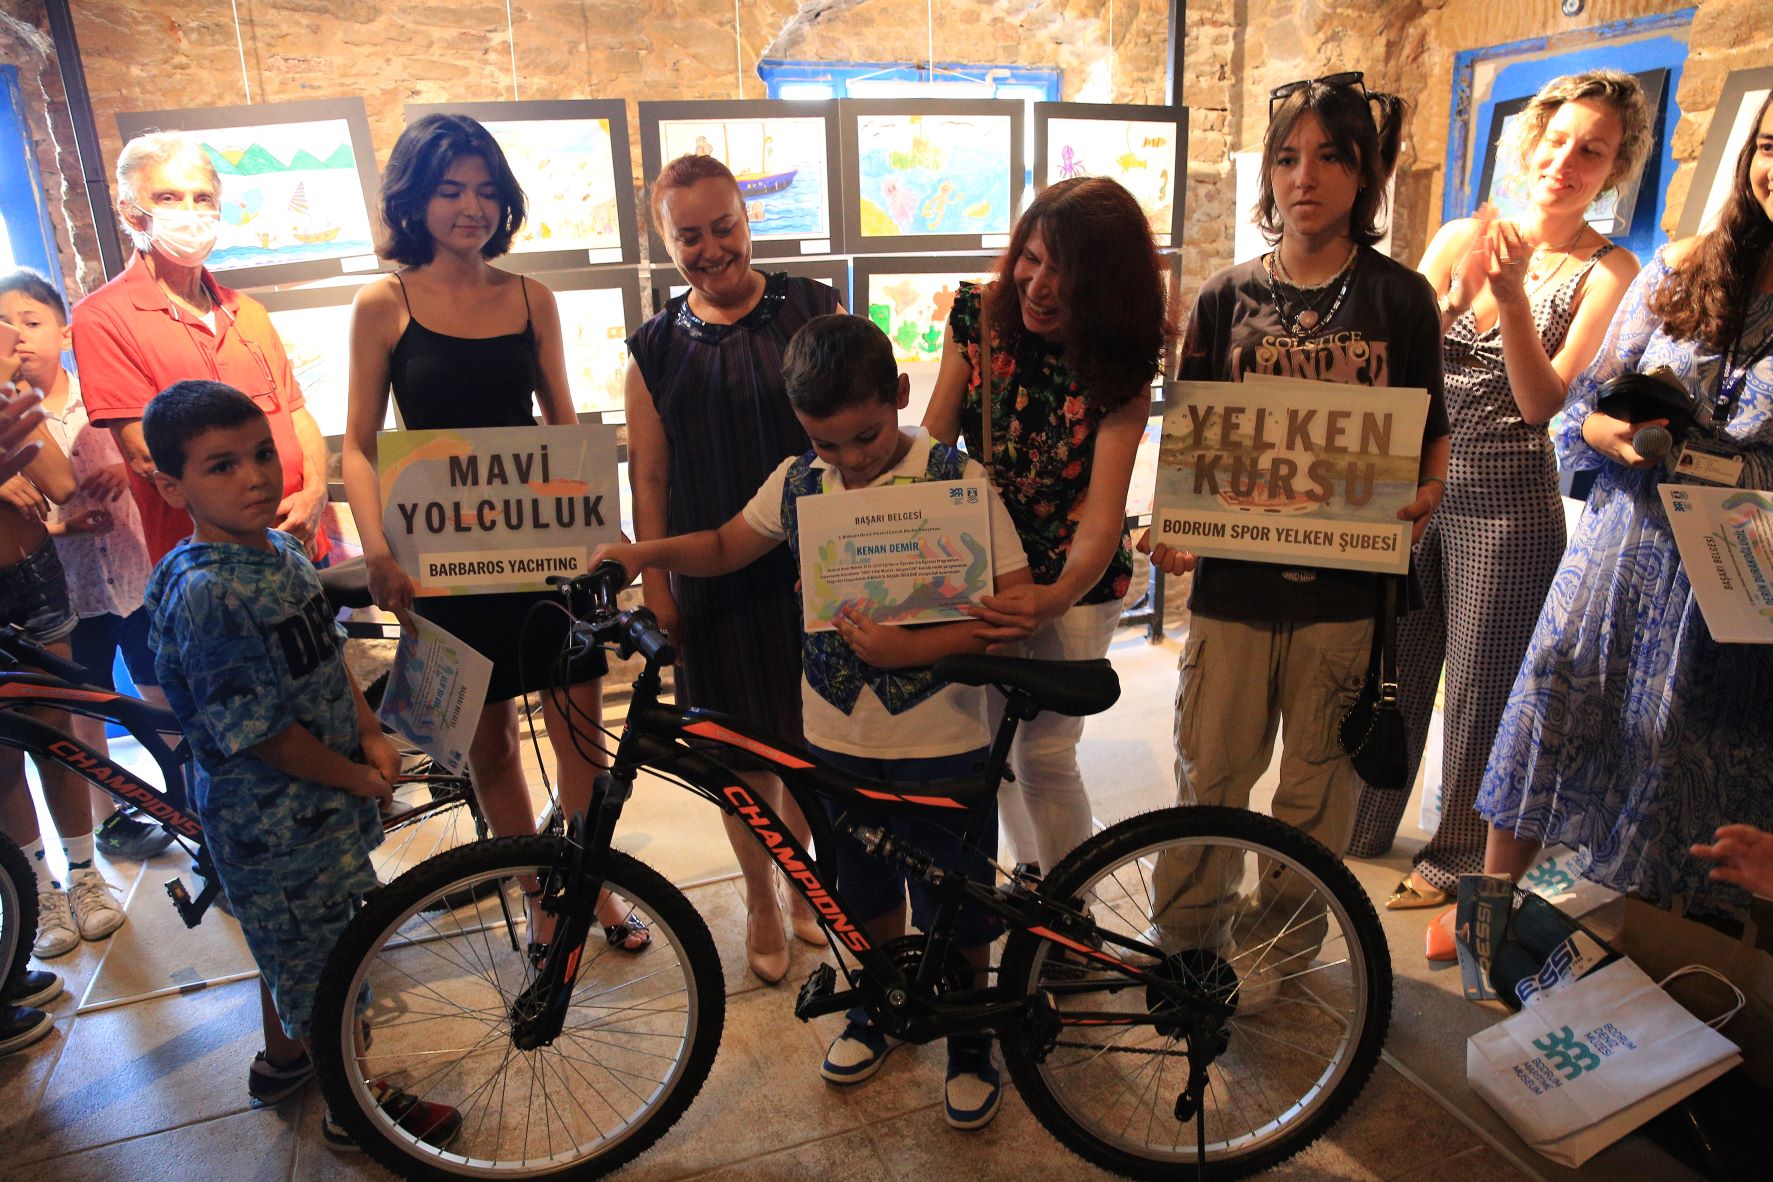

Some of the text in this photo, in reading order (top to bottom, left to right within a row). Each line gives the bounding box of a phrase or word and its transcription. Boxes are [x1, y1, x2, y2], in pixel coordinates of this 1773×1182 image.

[1187, 404, 1393, 456] YELKEN
[449, 444, 550, 487] MAVİ
[1192, 453, 1376, 507] KURSU
[397, 495, 605, 535] YOLCULUK
[855, 509, 922, 527] BAŞARI BELGESİ
[1162, 518, 1398, 552] BODRUM SPOR YELKEN ŞUBESİ
[429, 557, 578, 577] BARBAROS YACHTING
[856, 541, 919, 556] KENAN DEMİR
[48, 740, 203, 837] CHAMPIONS
[722, 785, 871, 952] CHAMPIONS
